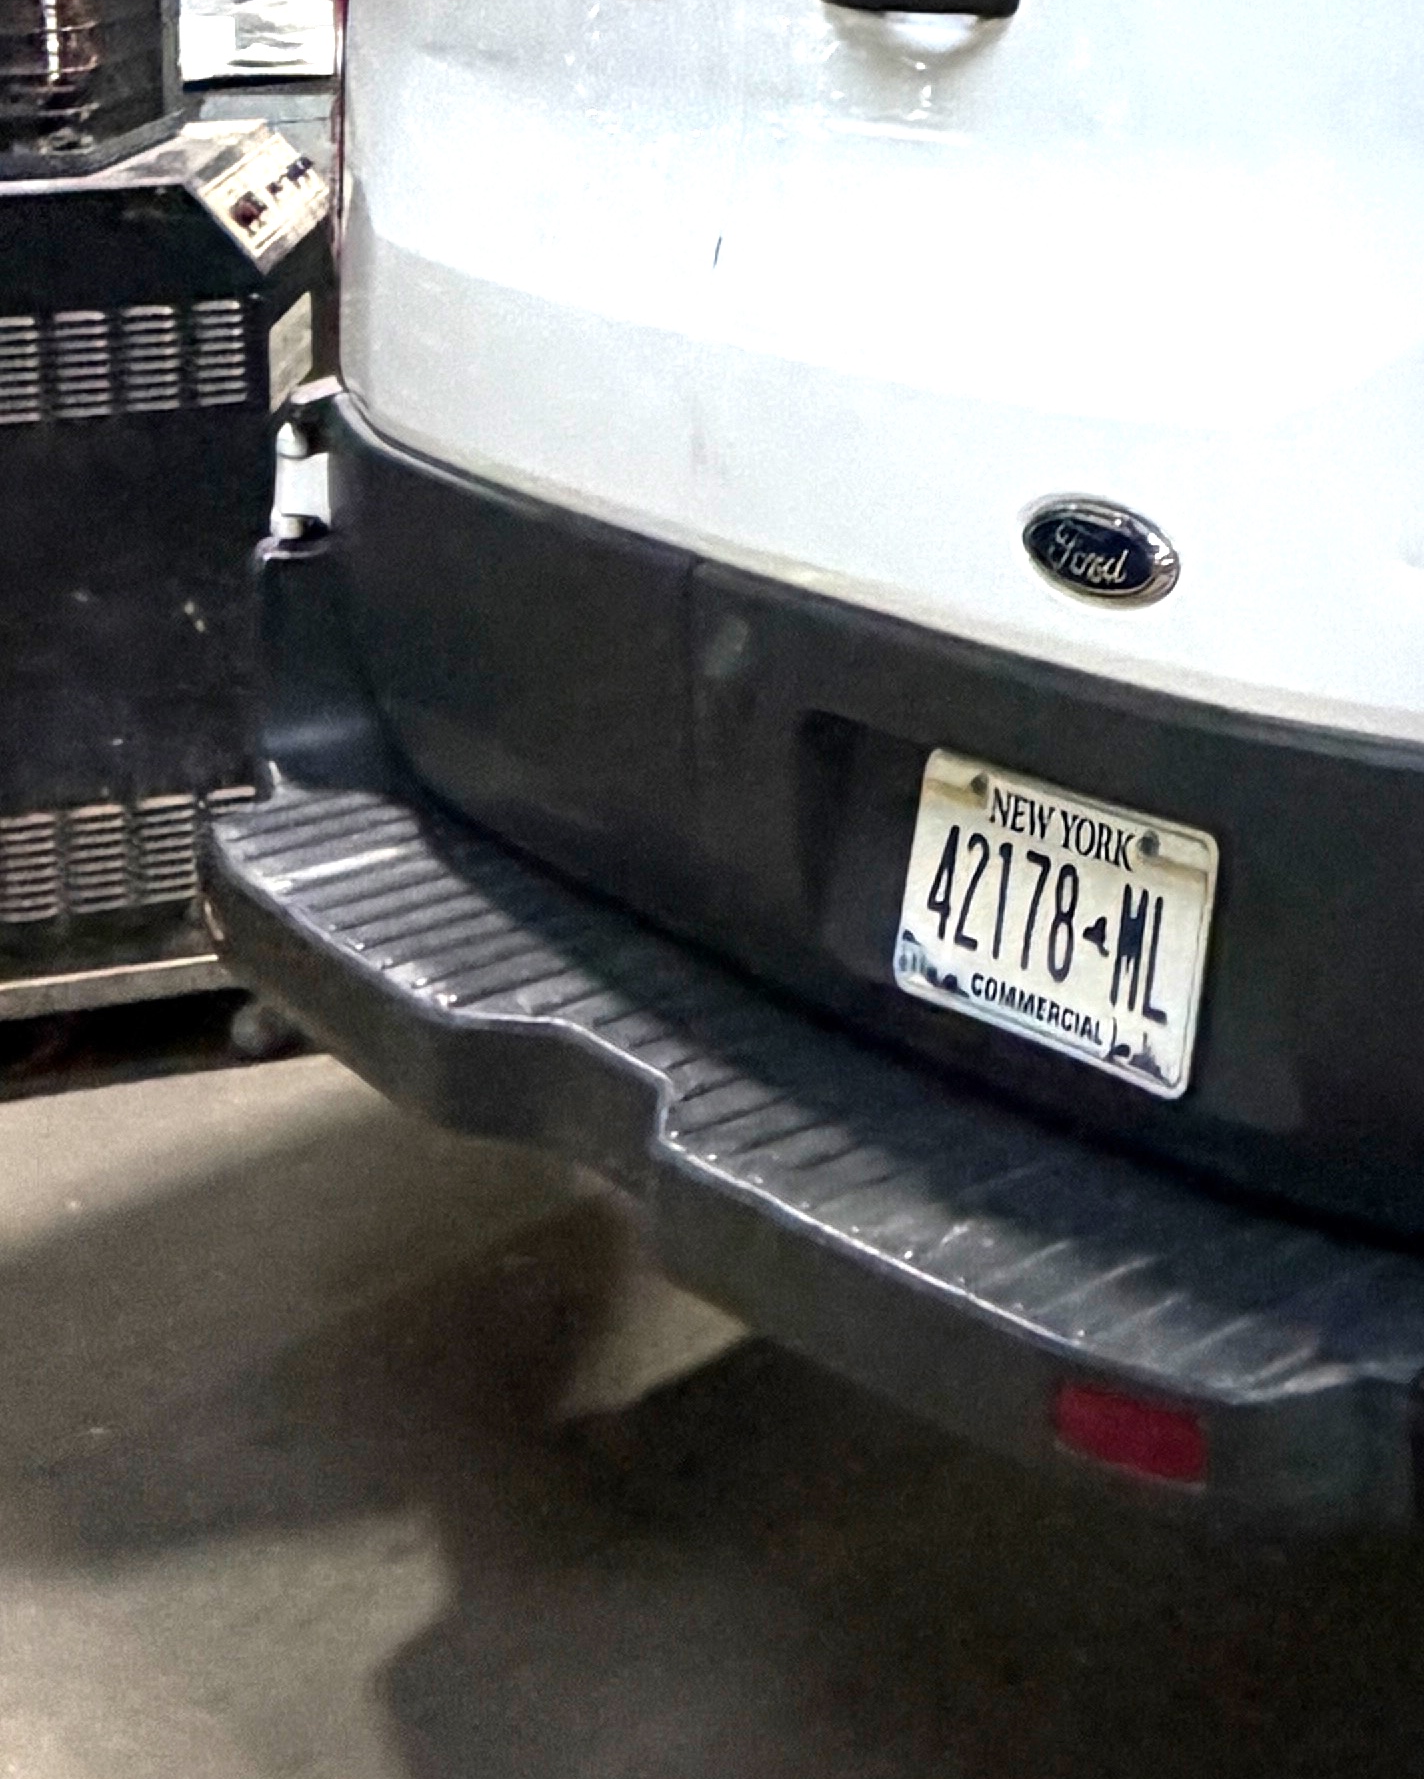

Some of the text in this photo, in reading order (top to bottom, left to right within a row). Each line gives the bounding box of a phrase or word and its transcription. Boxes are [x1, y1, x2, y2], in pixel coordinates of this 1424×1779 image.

[1049, 520, 1129, 585] Ford
[988, 787, 1137, 873] NEW YORK
[926, 824, 1080, 983] 42178
[970, 972, 1104, 1046] COMMERCIAL
